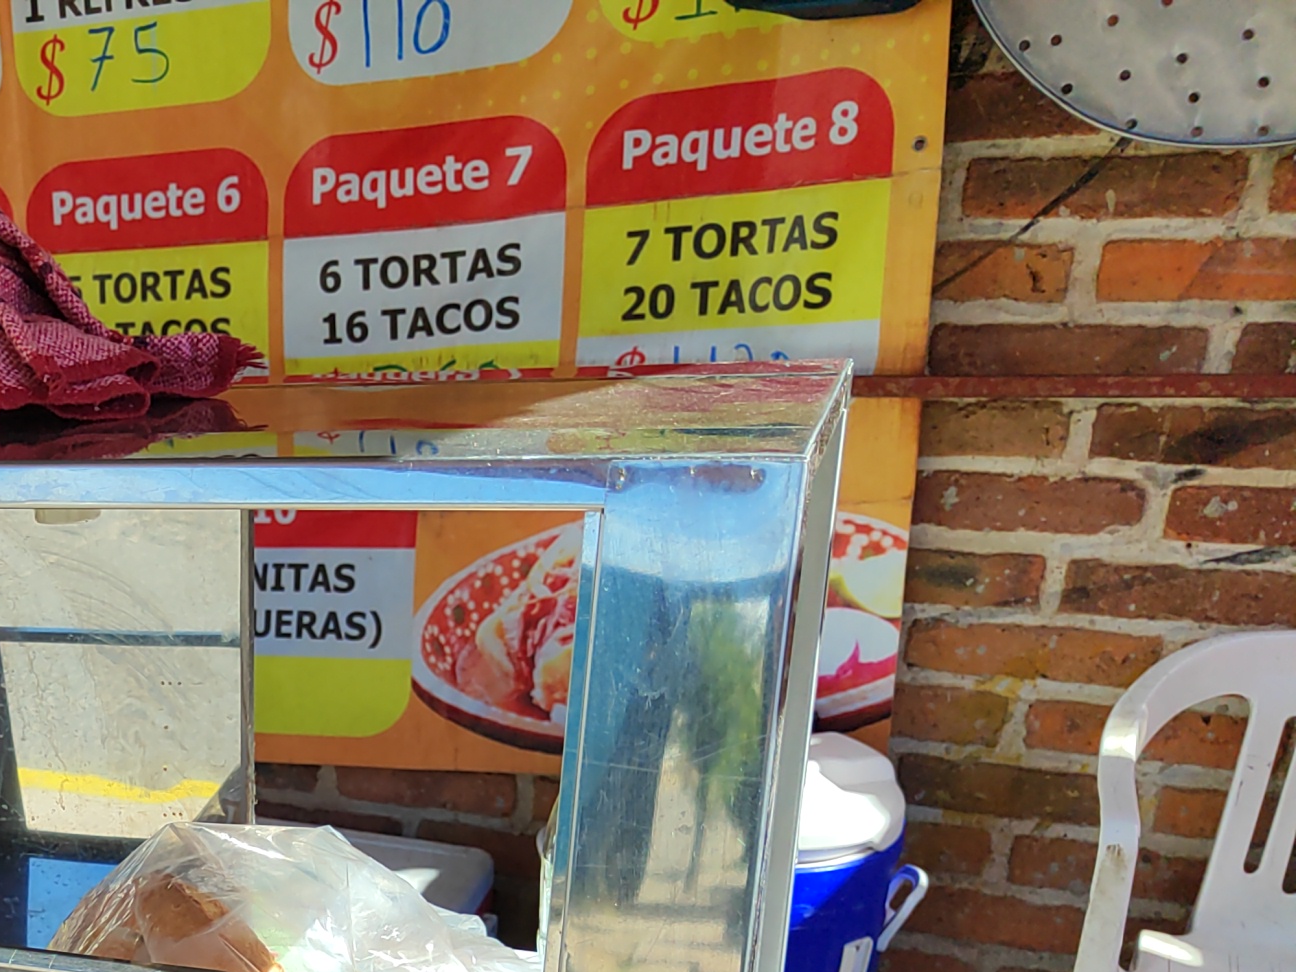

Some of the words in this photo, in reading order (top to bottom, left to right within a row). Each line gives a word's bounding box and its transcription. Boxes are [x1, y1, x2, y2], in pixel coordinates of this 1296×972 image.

[621, 112, 818, 172] Paquete
[828, 100, 860, 146] 8
[51, 182, 206, 231] Paquete
[216, 175, 241, 213] 6
[311, 155, 490, 209] Paquete
[504, 144, 534, 187] 7
[625, 229, 651, 267] 7
[664, 210, 840, 263] TORTAS
[92, 266, 232, 305] TORTAS
[318, 259, 342, 294] 6
[353, 242, 522, 292] TORTAS
[322, 310, 369, 345] 16
[380, 295, 521, 341] TACOS
[621, 283, 676, 322] 20
[689, 271, 834, 317] TACOS
